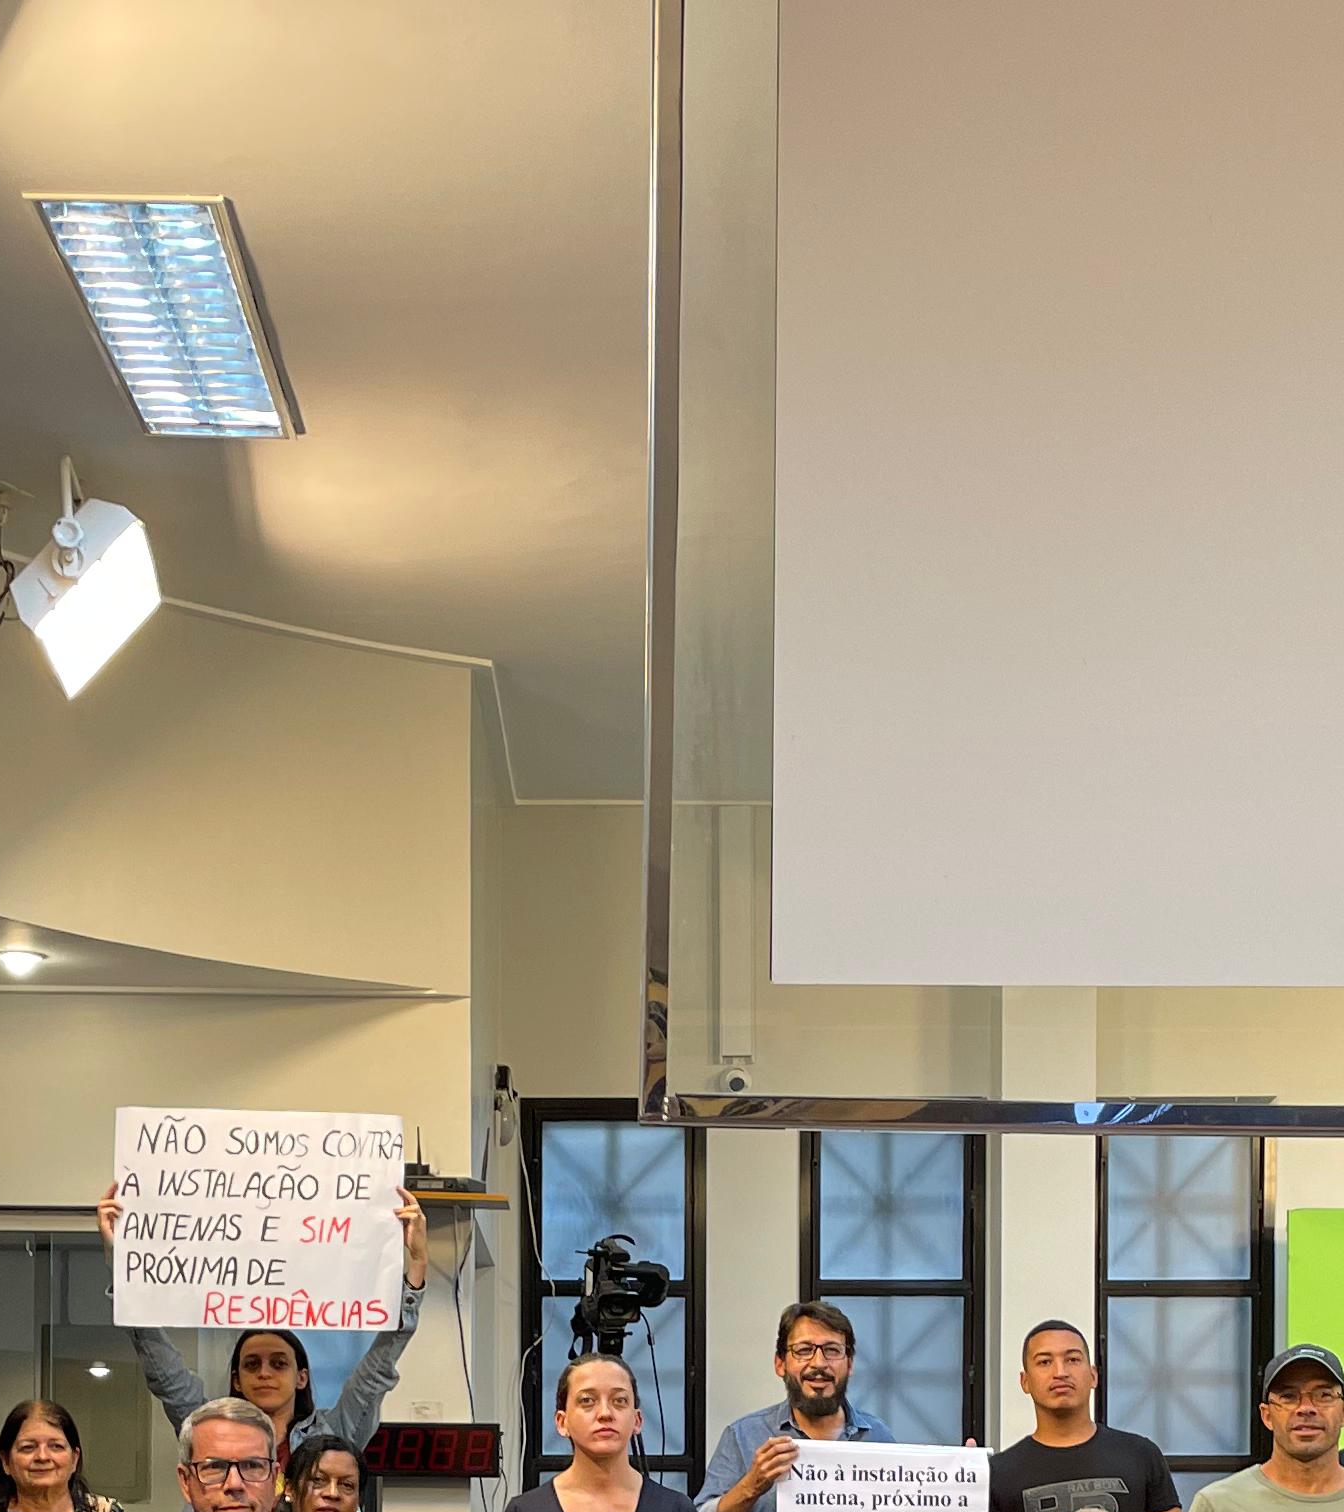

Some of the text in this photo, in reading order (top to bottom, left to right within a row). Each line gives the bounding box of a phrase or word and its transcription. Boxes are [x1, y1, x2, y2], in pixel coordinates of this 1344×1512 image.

[137, 1115, 403, 1160] NÃO SOMOS CONTRA
[120, 1164, 371, 1209] À INSTALAÇÃO DE
[123, 1211, 351, 1244] ANTENAS E SIM
[126, 1246, 287, 1286] PRÓXIMA DE
[203, 1289, 389, 1328] RESIDÊNCIAS
[788, 1463, 976, 1486] Não à instalação da
[795, 1489, 968, 1511] antena, próximo a
